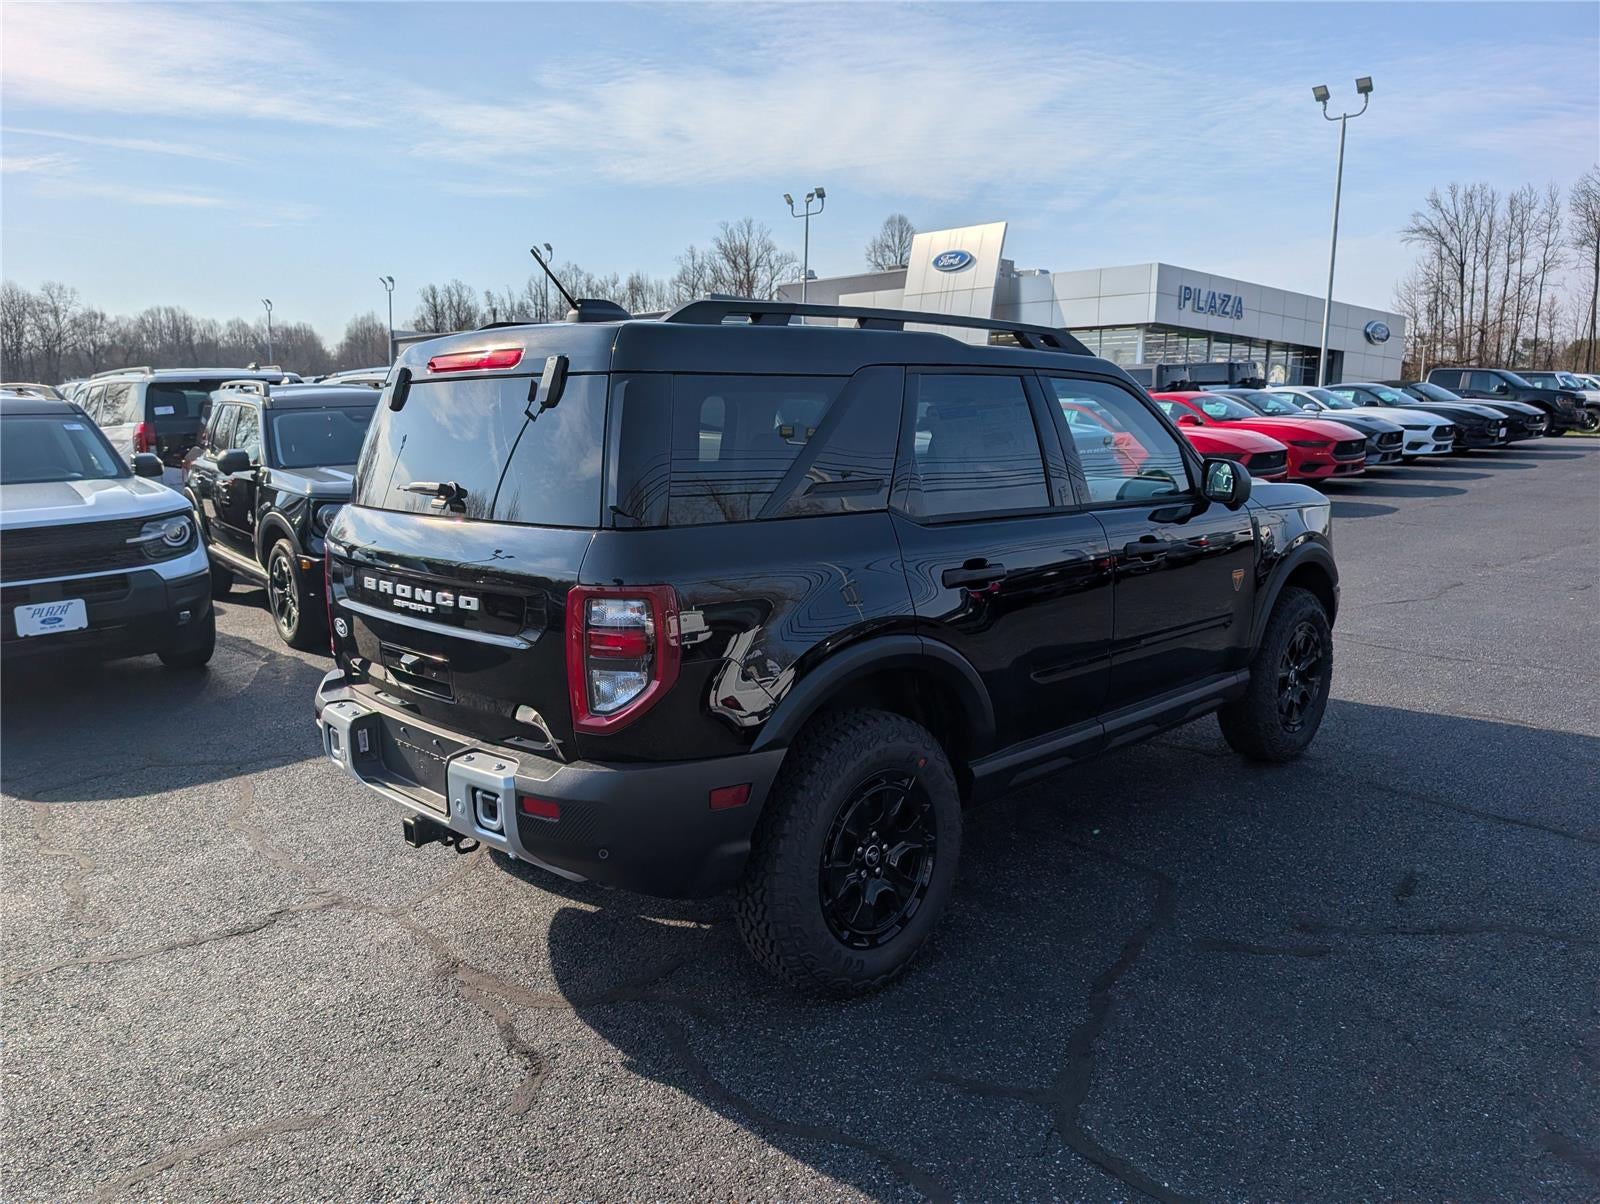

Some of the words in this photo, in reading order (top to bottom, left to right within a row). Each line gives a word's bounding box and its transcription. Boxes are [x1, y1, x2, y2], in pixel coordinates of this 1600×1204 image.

[935, 252, 964, 268] Ford
[1180, 285, 1244, 319] PLAZA
[364, 576, 480, 610] BRONCO
[31, 605, 70, 618] PLAZA
[393, 599, 435, 614] SPORT
